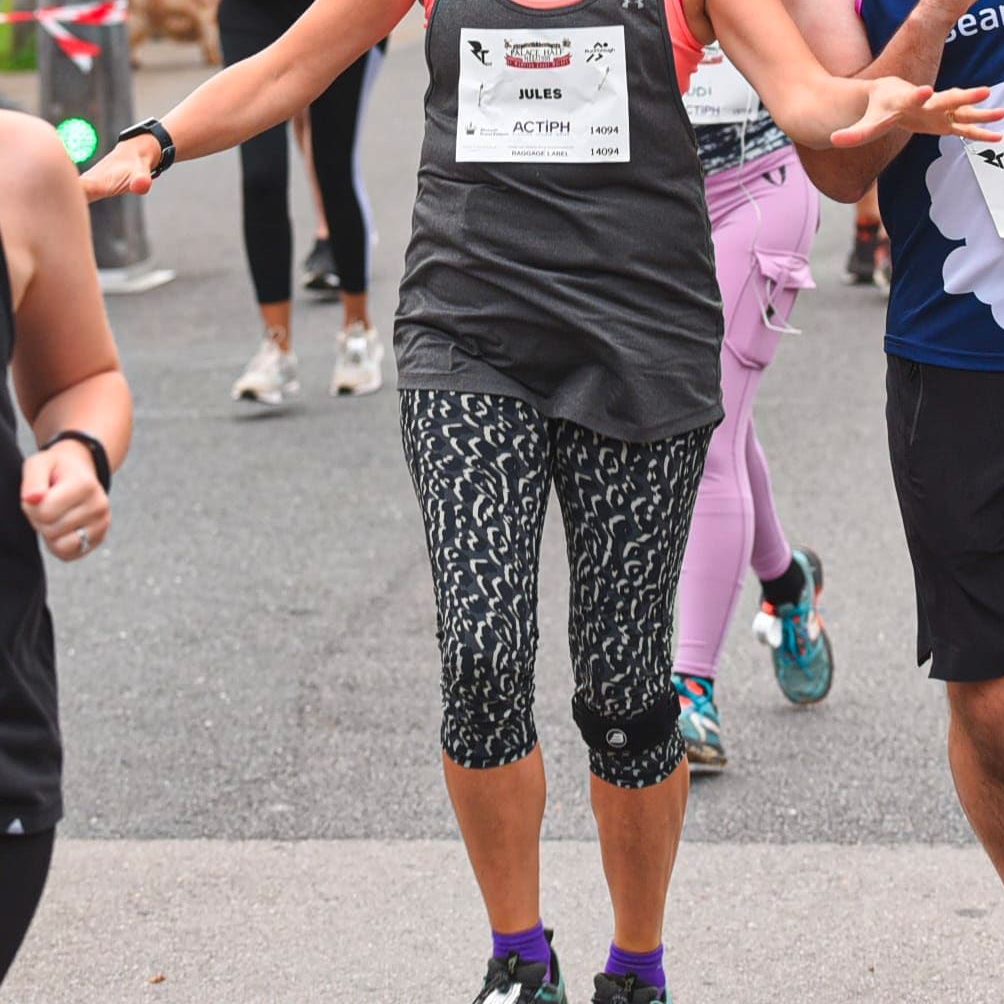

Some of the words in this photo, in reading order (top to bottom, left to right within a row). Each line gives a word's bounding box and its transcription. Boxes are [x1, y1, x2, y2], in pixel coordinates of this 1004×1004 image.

[518, 88, 563, 100] JULES
[590, 126, 619, 136] 14094
[590, 147, 620, 157] 14094
